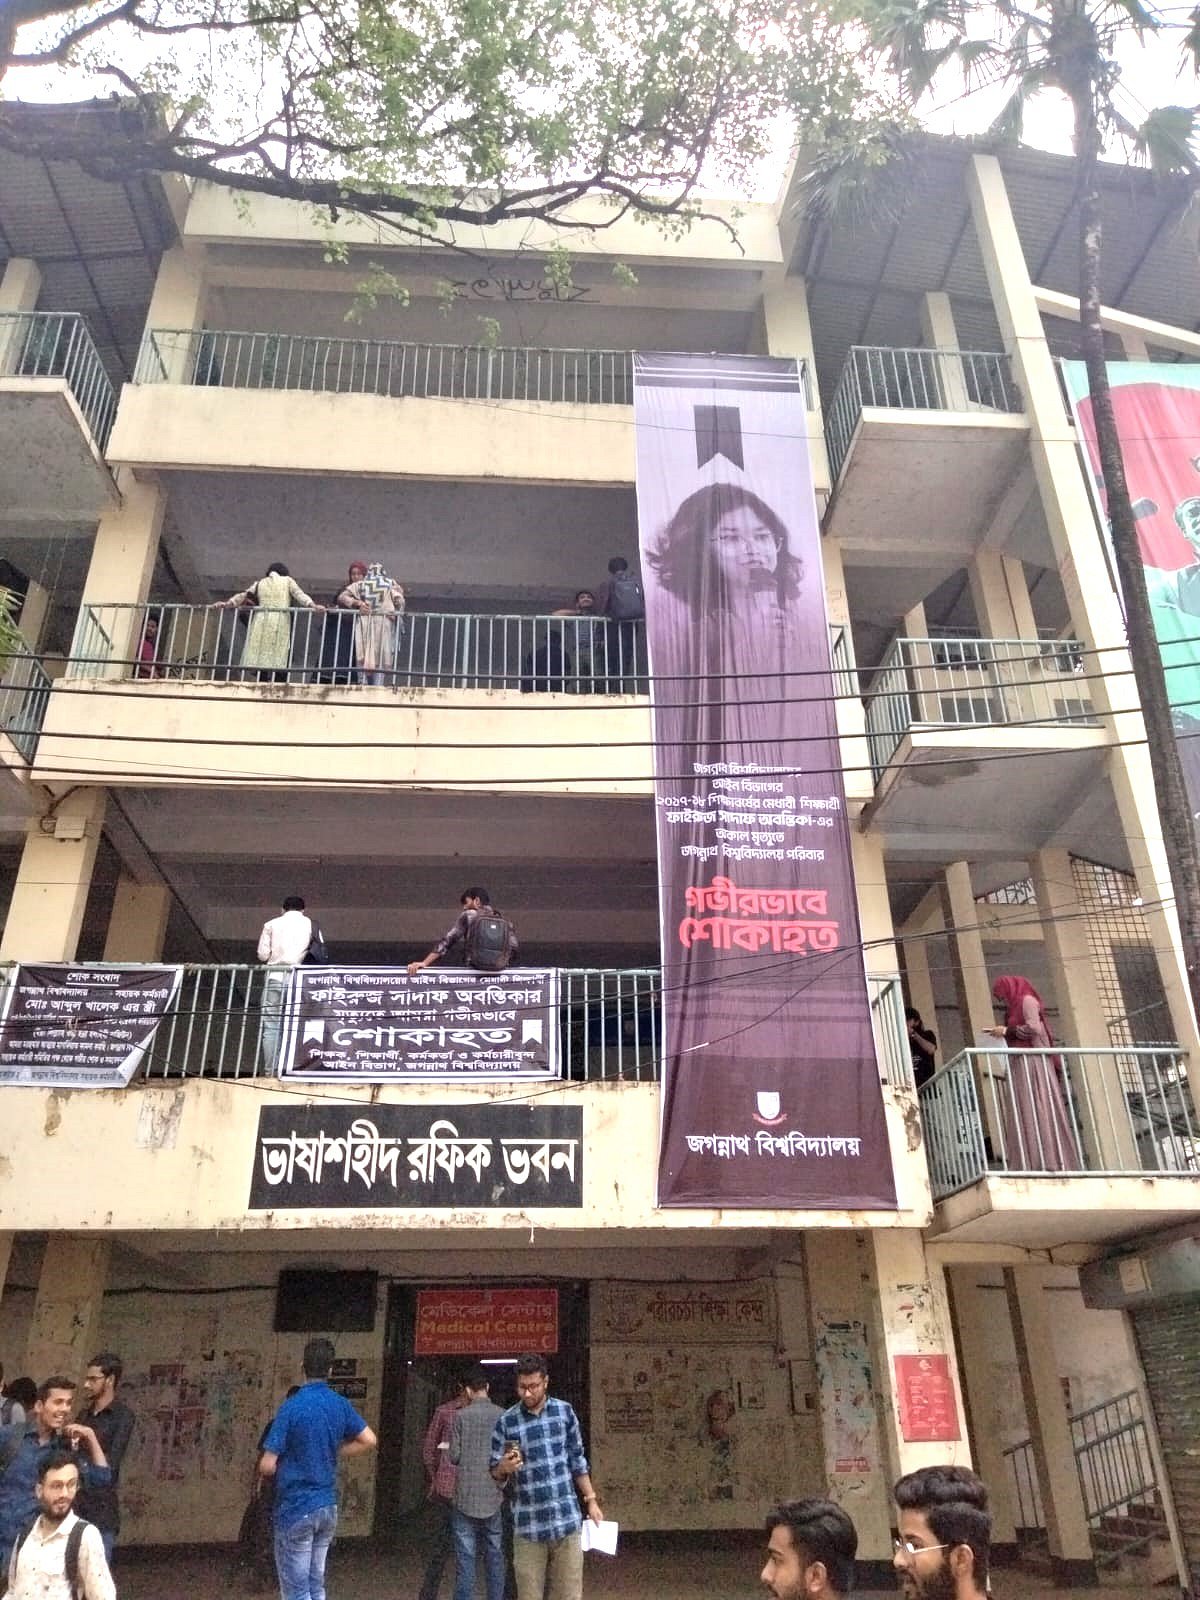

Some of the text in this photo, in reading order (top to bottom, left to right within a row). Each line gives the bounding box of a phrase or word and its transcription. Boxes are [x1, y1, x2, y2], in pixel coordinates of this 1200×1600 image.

[712, 778, 783, 794] আইন বিভাগের
[656, 794, 706, 808] ২০১৭-১৮
[708, 793, 760, 809] শিক্ষাবর্ষের
[762, 796, 796, 810] মেধাবী
[665, 808, 716, 824] ফাইরুজ
[718, 810, 756, 825] সাদাফ
[715, 828, 785, 847] অকাল মৃত্যুতে
[681, 843, 825, 862] জগন্নাথ বিশ্ববিদ্যালয় পরিবার
[685, 875, 828, 916] গভীরভাবে
[679, 917, 840, 956] শোকাহত
[410, 975, 436, 985] আইন
[309, 985, 543, 1006] ফাইরুজ সাদাফ অবন্তিকার
[444, 1006, 517, 1023] গভীরভাবে
[332, 1026, 517, 1049] শোকাহত
[457, 1051, 468, 1060] ও
[323, 1060, 357, 1070] আইন
[452, 1060, 521, 1071] বিশ্ববিদ্যালয়
[685, 1130, 862, 1159] জগন্নাথ বিশ্ববিদ্যালয়
[261, 1118, 579, 1190] ভাষাশহীদ রফিক ভবন
[420, 1320, 555, 1333] Medical Centre
